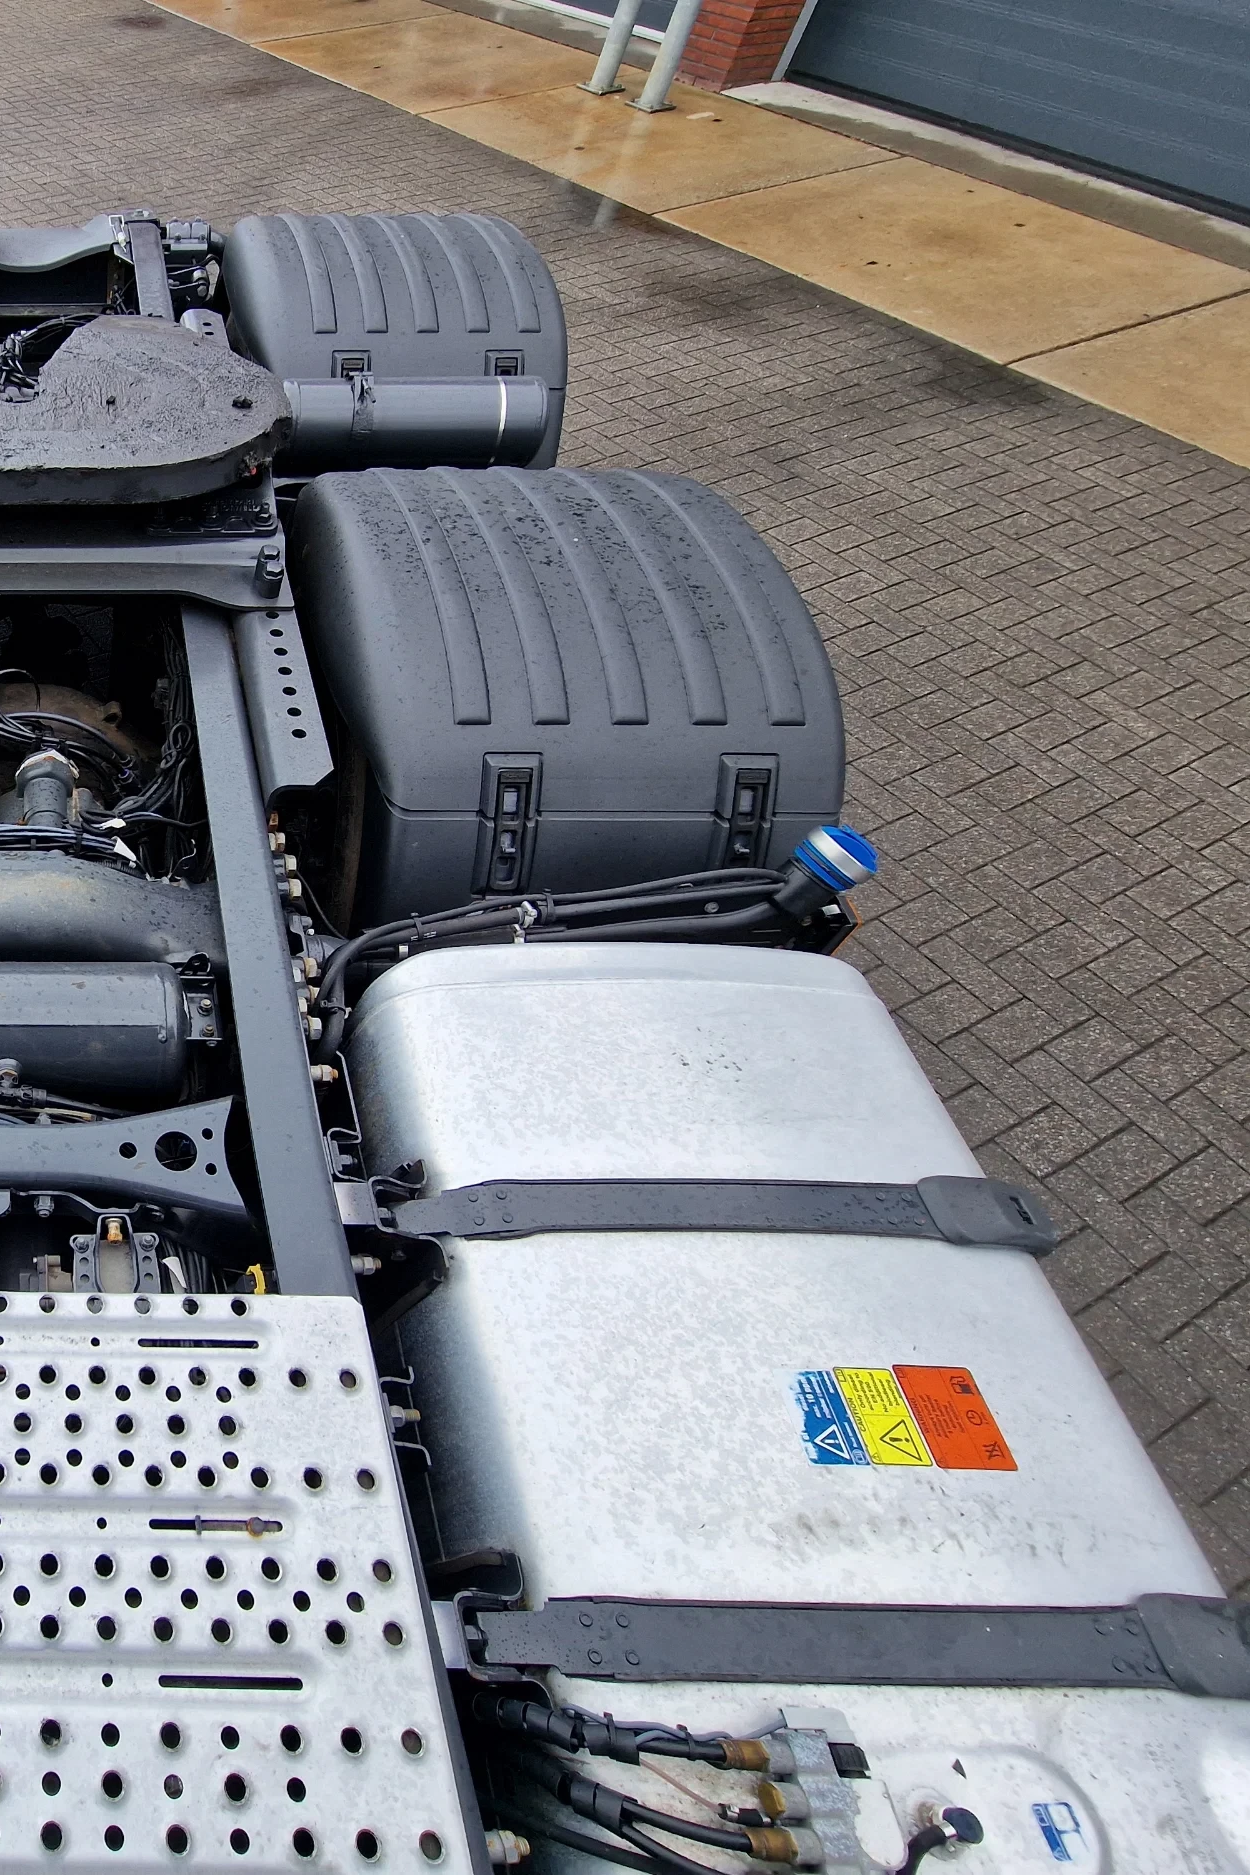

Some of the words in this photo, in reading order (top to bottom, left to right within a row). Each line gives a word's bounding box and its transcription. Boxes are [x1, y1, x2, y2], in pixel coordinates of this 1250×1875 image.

[805, 1393, 815, 1402] 10
[855, 1393, 867, 1408] Only
[846, 1397, 867, 1432] CAUTION
[880, 1403, 889, 1412] No
[908, 1397, 931, 1433] WARNING
